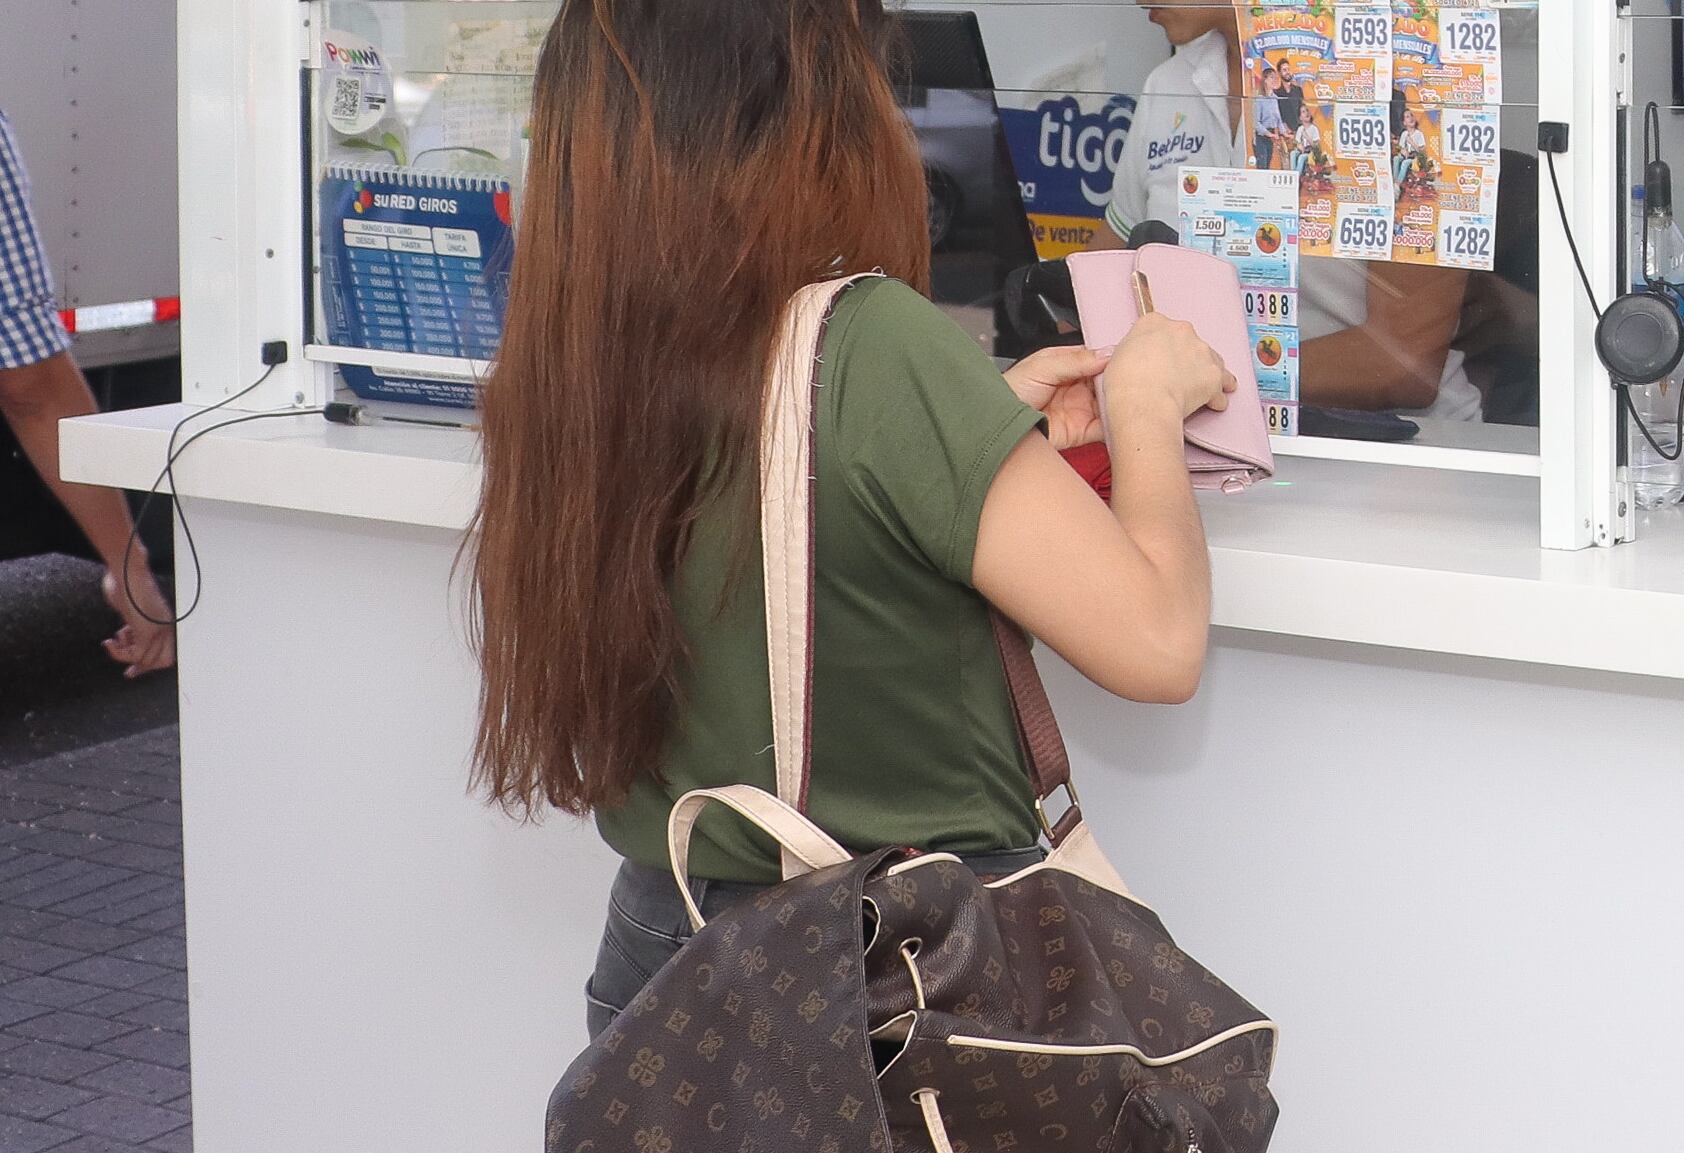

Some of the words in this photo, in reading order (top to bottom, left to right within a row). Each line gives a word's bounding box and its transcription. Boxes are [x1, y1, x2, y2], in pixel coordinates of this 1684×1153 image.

[1340, 17, 1388, 47] 6593
[1447, 22, 1497, 52] 1282
[1148, 132, 1204, 160] BetPlay
[1339, 118, 1386, 148] 6593
[1447, 124, 1496, 155] 1282
[390, 195, 415, 209] RED
[419, 197, 457, 214] GIROS
[1195, 221, 1221, 230] 1.500
[1340, 217, 1387, 248] 6593
[1443, 225, 1490, 257] 1282
[1246, 292, 1289, 316] 0388
